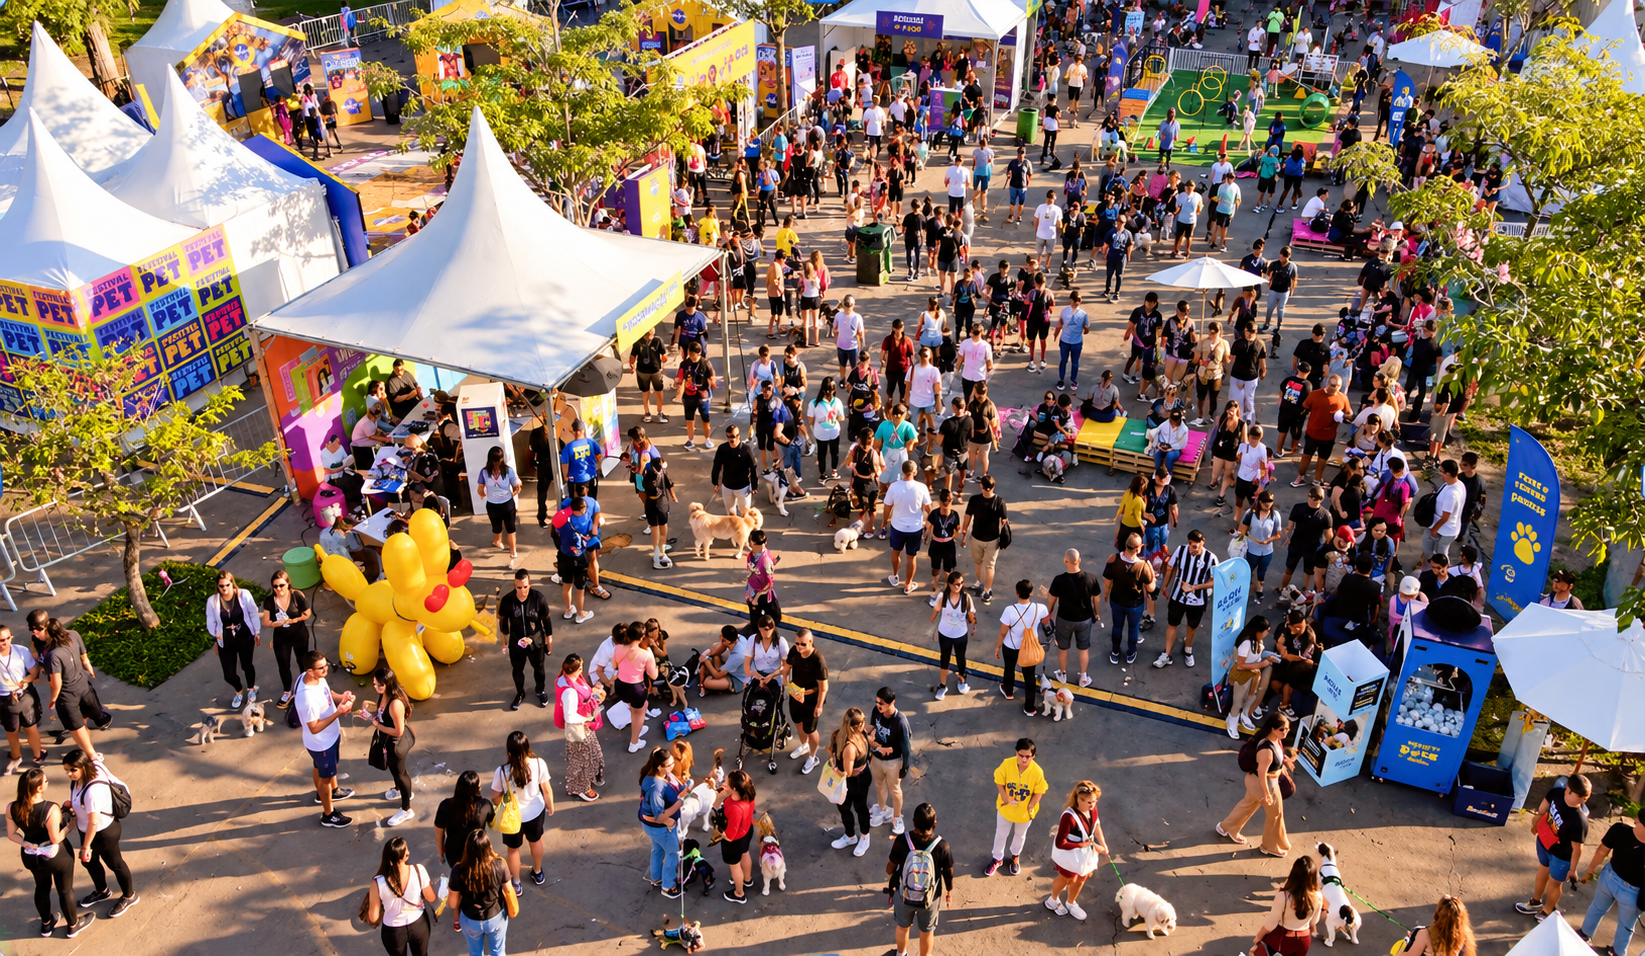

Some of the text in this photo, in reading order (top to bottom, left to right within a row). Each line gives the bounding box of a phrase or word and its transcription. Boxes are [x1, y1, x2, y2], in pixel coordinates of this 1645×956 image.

[187, 238, 225, 271] PET
[140, 258, 181, 294] PET
[198, 274, 233, 307] PET
[35, 300, 75, 325] PET
[90, 281, 132, 317] PET
[152, 295, 192, 331] PET
[2, 329, 40, 354] PET
[207, 307, 242, 341] PET
[164, 330, 201, 365] PET
[217, 339, 251, 374] PET
[174, 363, 212, 399] PET
